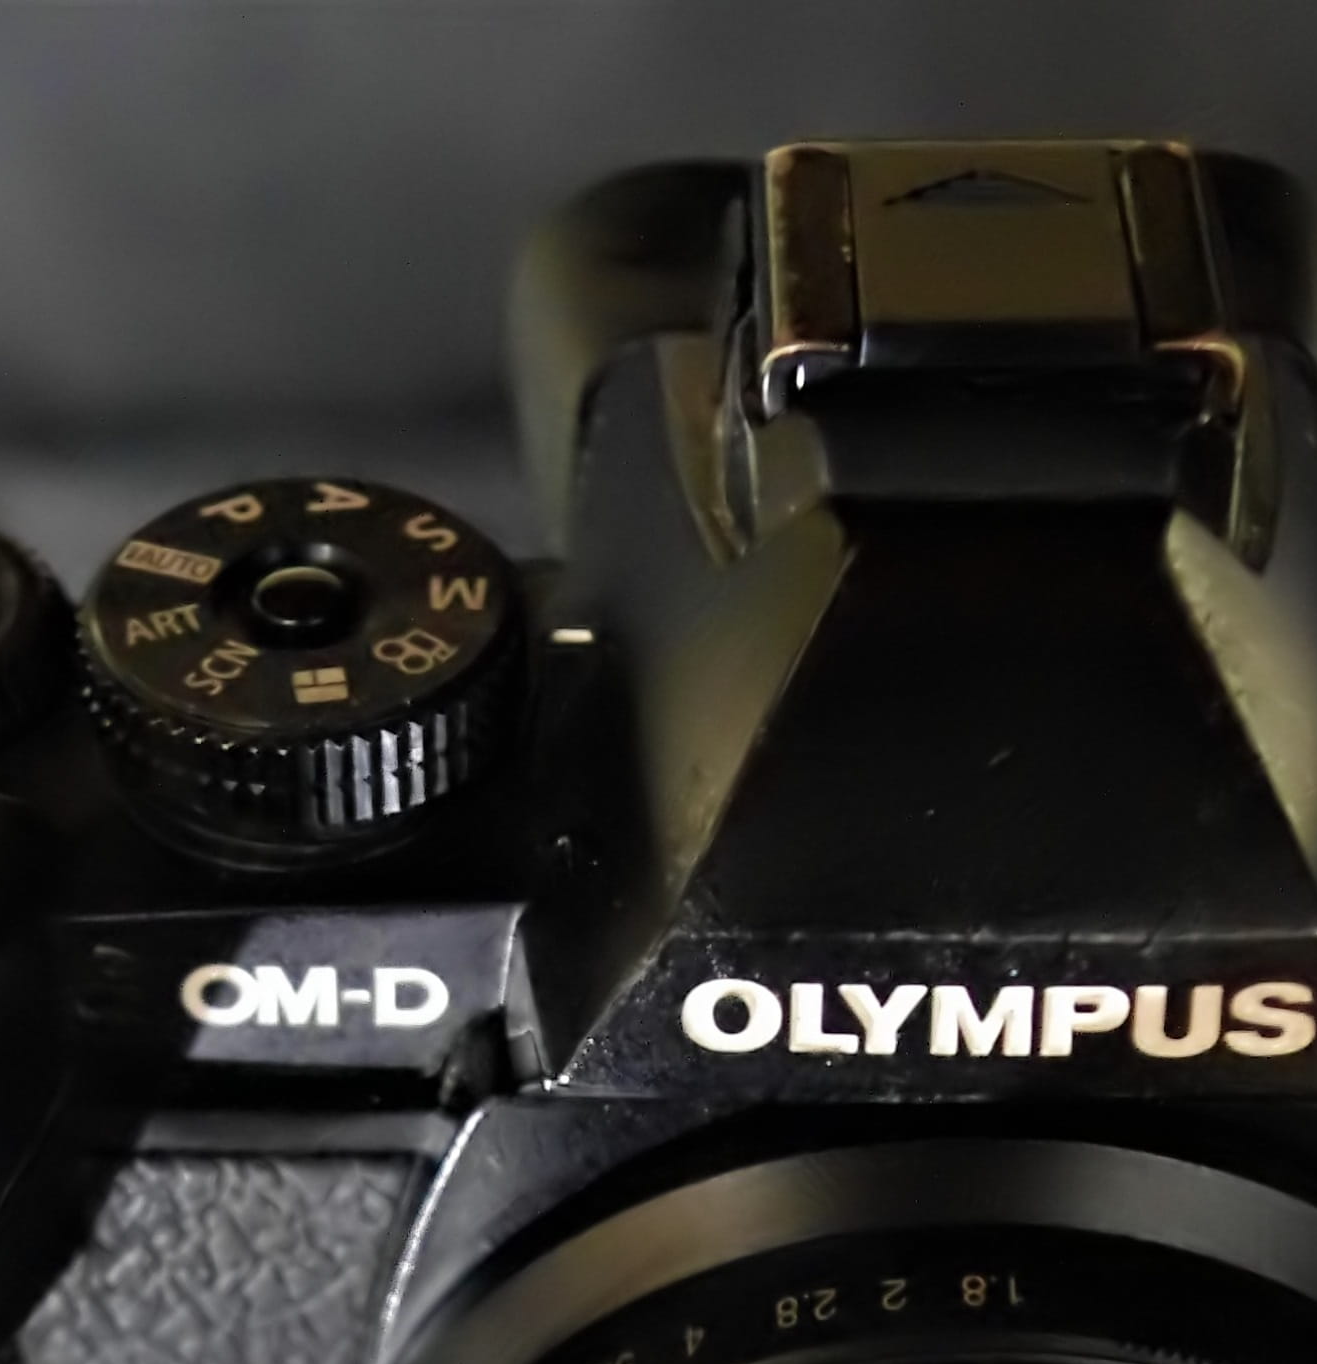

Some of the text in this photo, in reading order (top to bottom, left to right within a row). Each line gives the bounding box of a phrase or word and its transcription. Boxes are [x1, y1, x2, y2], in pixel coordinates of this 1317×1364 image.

[198, 493, 264, 524] P
[306, 481, 371, 513] A
[403, 512, 459, 552] S
[428, 575, 488, 612] M
[124, 602, 201, 648] ART
[184, 639, 261, 696] SCN
[183, 963, 451, 1029] OM-D
[680, 975, 1317, 1059] OLYMPUS
[774, 1286, 838, 1330] 2.8
[880, 1277, 908, 1313] 2
[960, 1273, 1023, 1308] 1.8
[683, 1325, 706, 1358] 4
